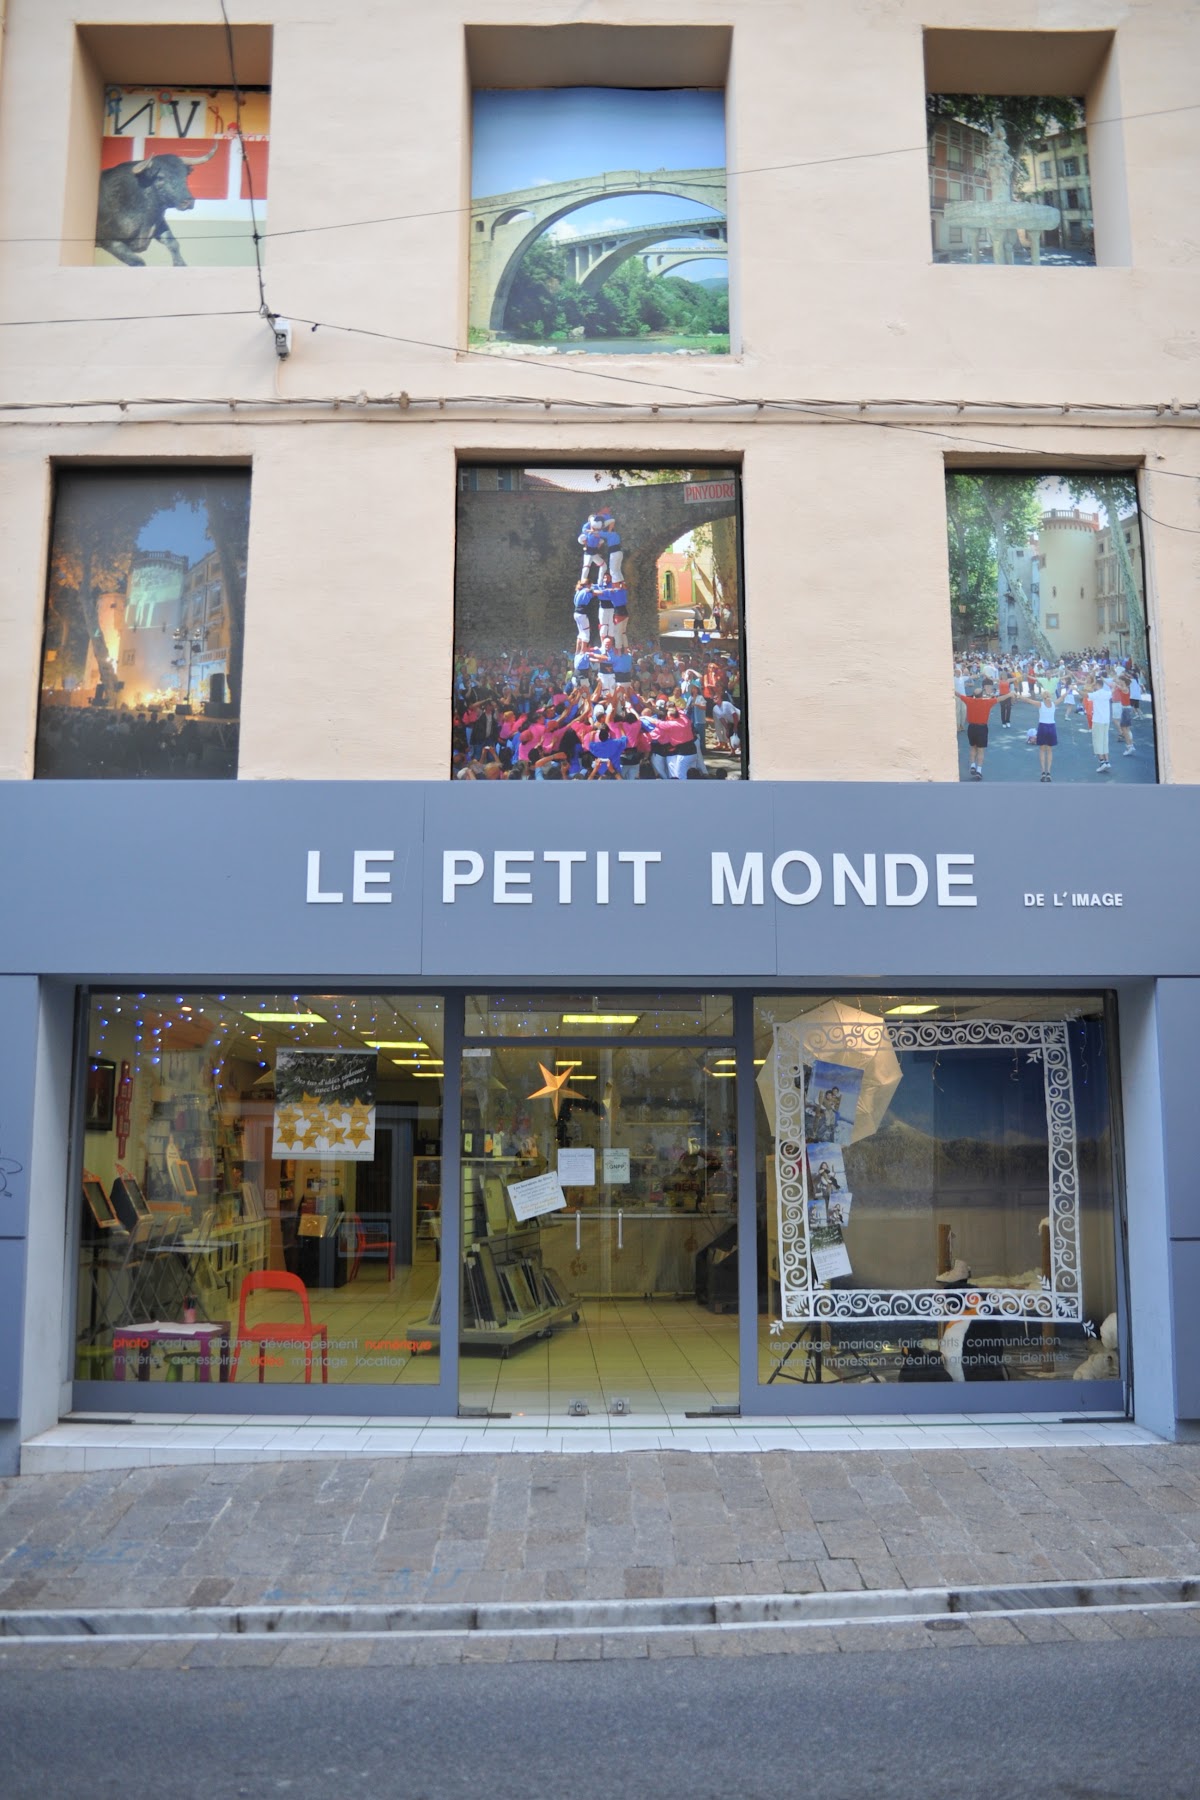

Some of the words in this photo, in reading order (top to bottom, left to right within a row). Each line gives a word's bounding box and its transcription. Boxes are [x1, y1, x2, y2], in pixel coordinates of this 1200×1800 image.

[306, 850, 395, 903] LE
[442, 850, 662, 904] PETIT
[711, 849, 978, 907] MONDE
[1024, 893, 1045, 907] DE
[1053, 891, 1123, 907] L'IMAGE
[113, 1337, 149, 1350] photo
[156, 1338, 198, 1349] cadres
[208, 1338, 251, 1349] albums
[259, 1338, 358, 1353] développement
[365, 1339, 432, 1352] numérique
[769, 1339, 831, 1352] reportage
[838, 1338, 891, 1351] mariage
[898, 1337, 923, 1349] faire
[966, 1335, 1061, 1348] communication
[171, 1355, 243, 1366] accessoires
[248, 1356, 284, 1367] vidéo
[291, 1356, 348, 1368] montage
[355, 1355, 406, 1367] location
[770, 1357, 815, 1367] internet
[823, 1356, 887, 1368] impression
[894, 1353, 944, 1366] création
[1019, 1351, 1069, 1364] identités
